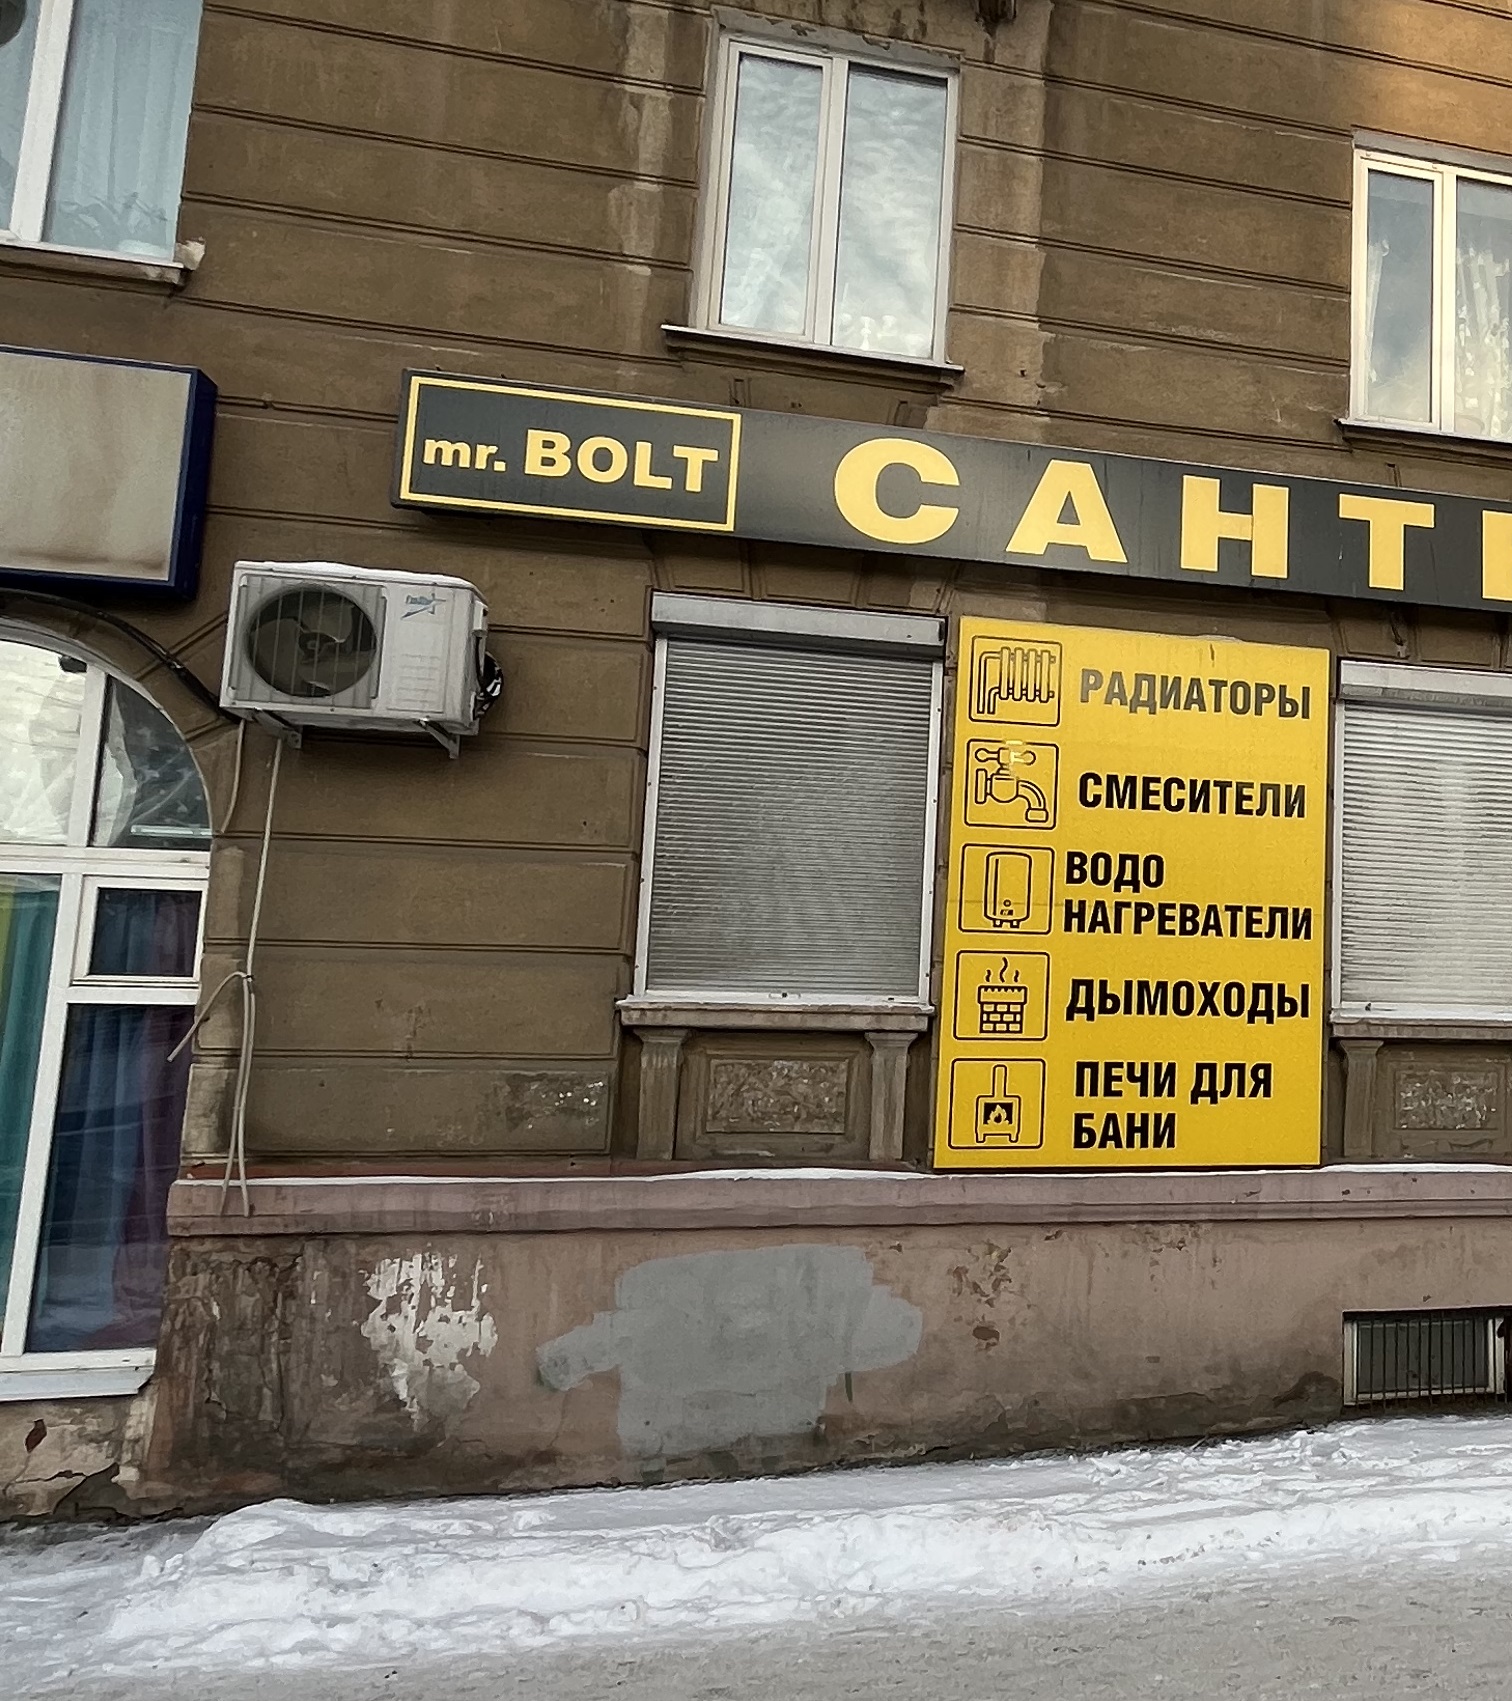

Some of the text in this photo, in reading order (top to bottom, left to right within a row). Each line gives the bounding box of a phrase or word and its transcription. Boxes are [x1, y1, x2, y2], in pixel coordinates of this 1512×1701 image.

[422, 427, 720, 493] mr. BOLT
[1080, 668, 1311, 720] РАДИАТОРЫ
[1078, 772, 1306, 819] СМЕСИТЕЛИ
[1065, 850, 1165, 894] ВОДО
[1063, 899, 1313, 941] НАГРЕВАТЕЛИ
[1065, 978, 1310, 1025] ДЫМОХОДЫ
[1075, 1060, 1272, 1106] ПЕЧИ ДЛЯ
[1073, 1112, 1176, 1149] БАНИ
